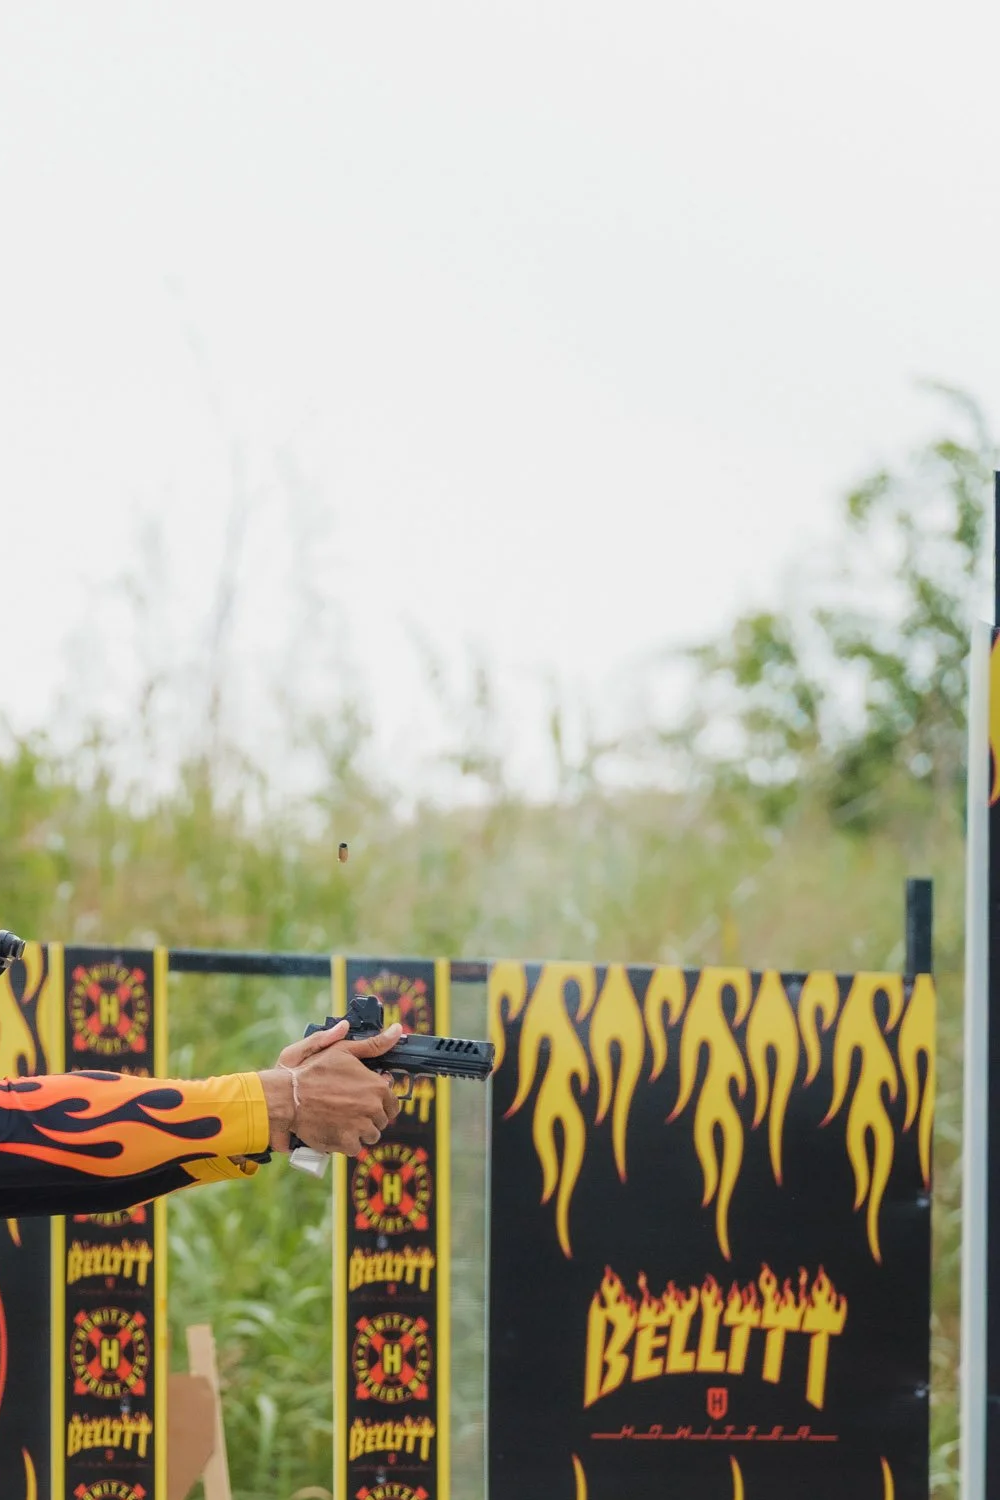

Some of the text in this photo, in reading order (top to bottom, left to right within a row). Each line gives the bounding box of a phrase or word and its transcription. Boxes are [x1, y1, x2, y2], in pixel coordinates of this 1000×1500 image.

[382, 1173, 402, 1206] H
[101, 1338, 120, 1370] H
[383, 1343, 402, 1375] H
